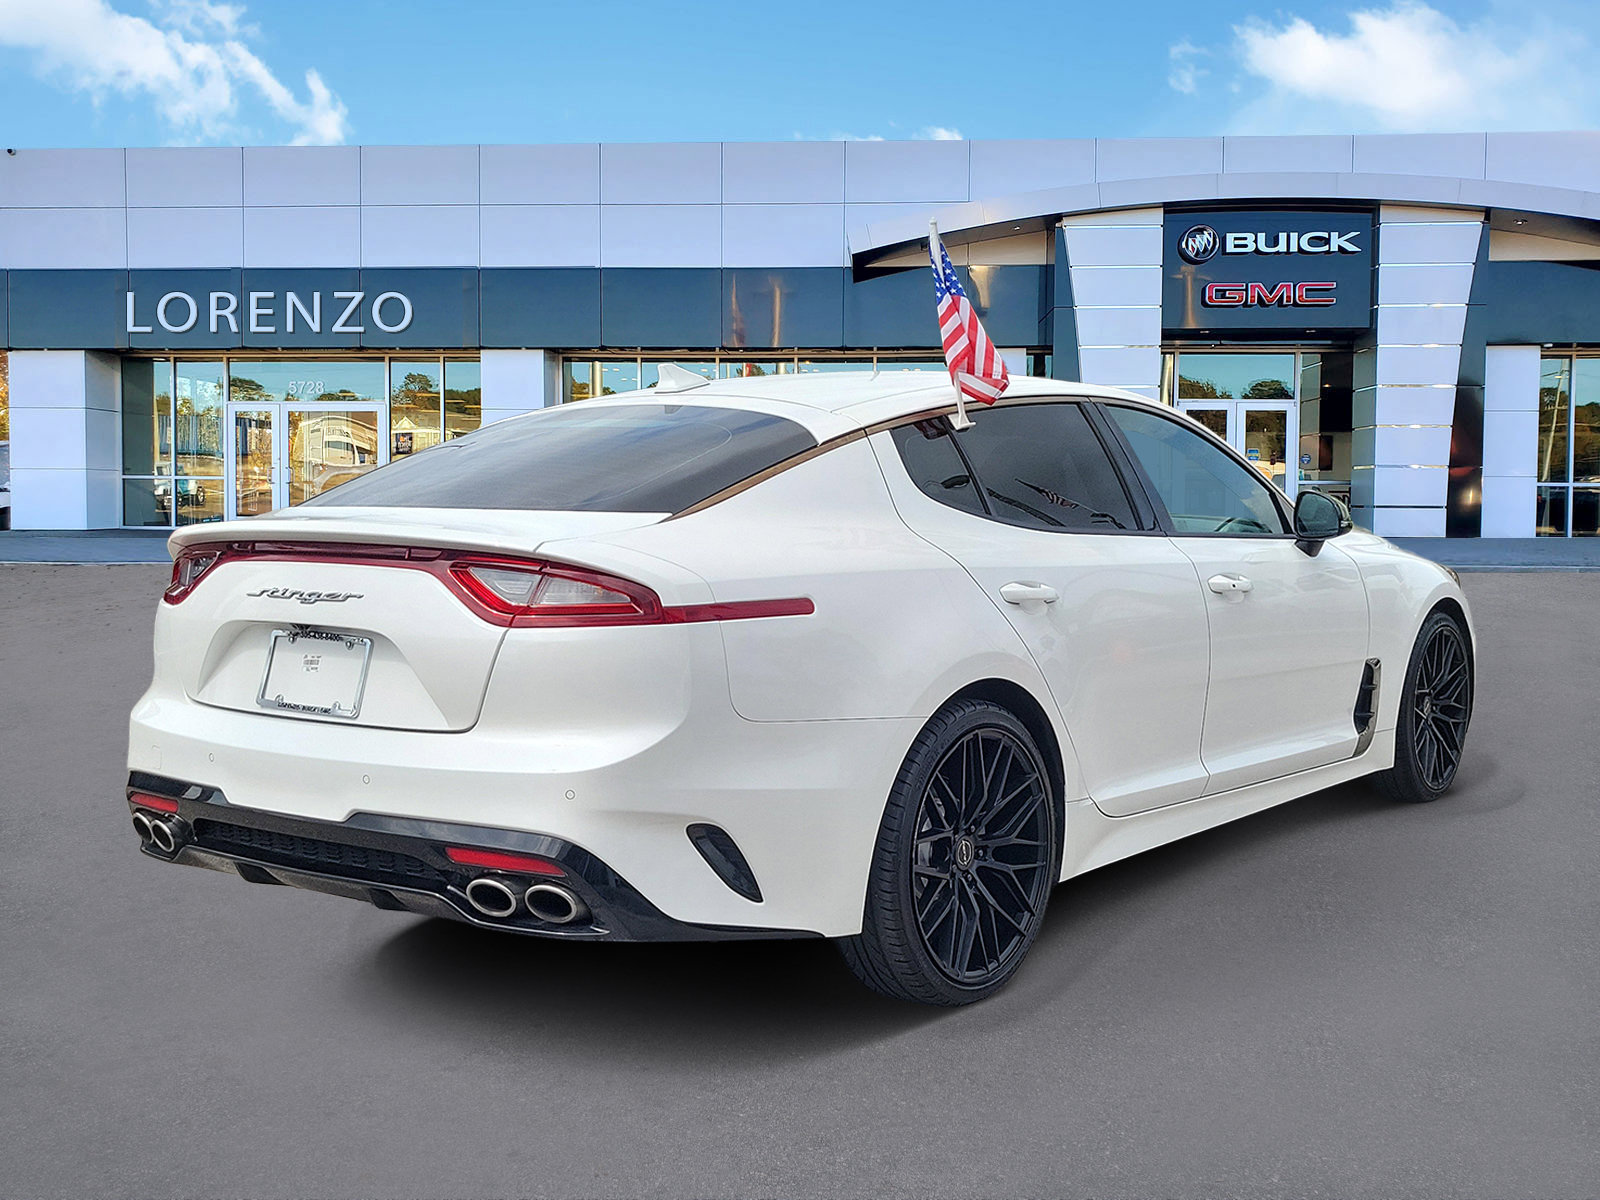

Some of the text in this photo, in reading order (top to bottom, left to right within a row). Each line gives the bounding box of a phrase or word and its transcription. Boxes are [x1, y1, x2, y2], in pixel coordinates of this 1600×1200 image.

[1225, 231, 1361, 253] BUICK
[1204, 281, 1336, 305] GMC
[126, 291, 413, 333] LORENZO
[288, 380, 325, 394] 5728
